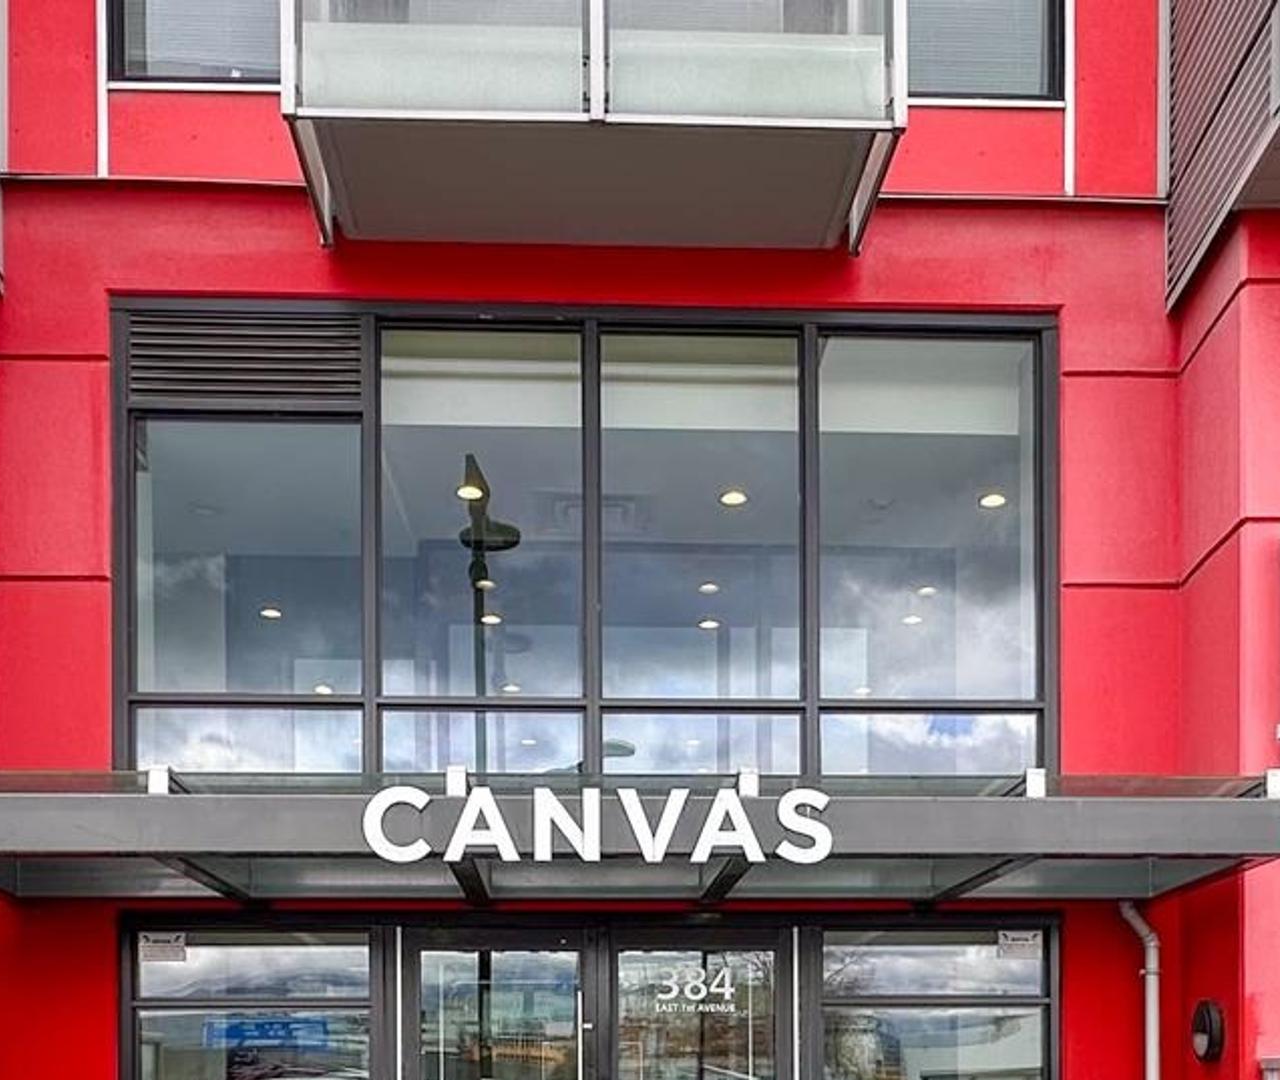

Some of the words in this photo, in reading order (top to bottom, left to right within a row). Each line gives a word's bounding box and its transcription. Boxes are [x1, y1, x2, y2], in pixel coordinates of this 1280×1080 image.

[362, 785, 833, 864] CANVAS
[657, 966, 735, 1000] 384
[656, 1003, 678, 1012] EAST
[697, 1003, 736, 1012] AVENUE
